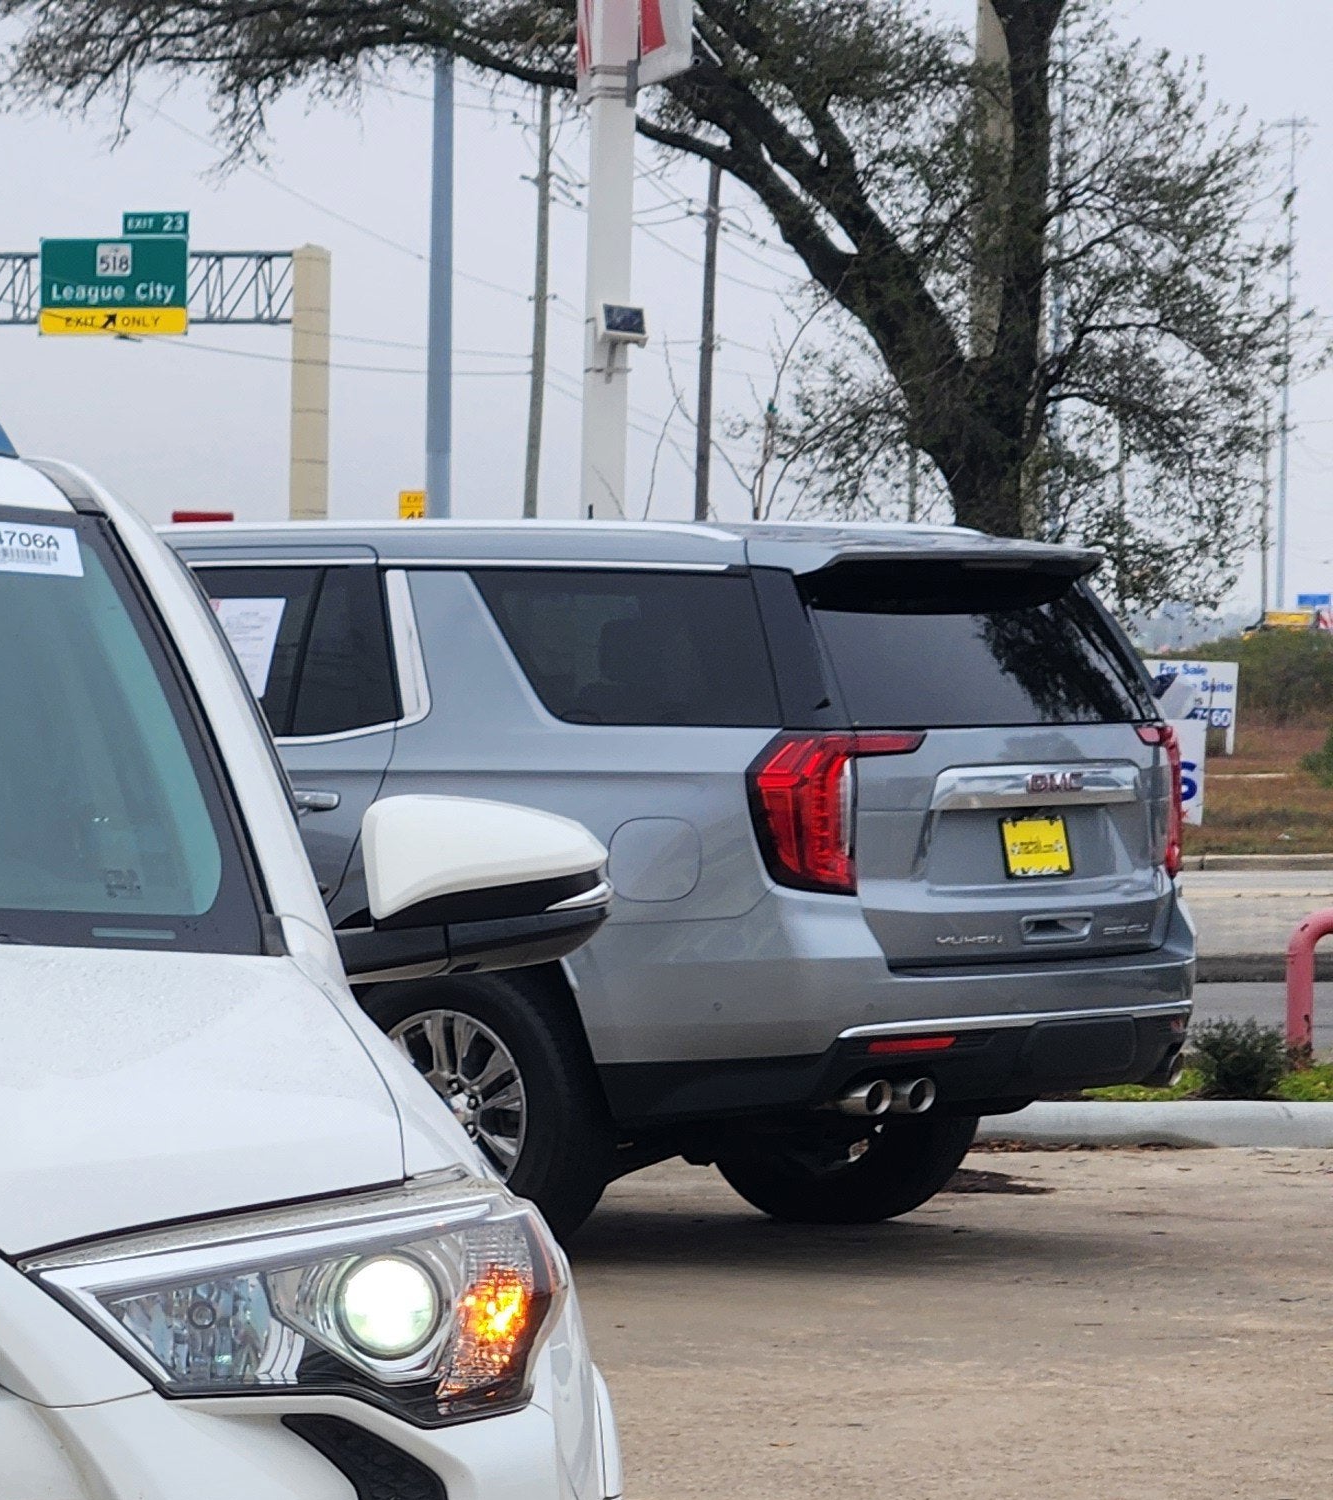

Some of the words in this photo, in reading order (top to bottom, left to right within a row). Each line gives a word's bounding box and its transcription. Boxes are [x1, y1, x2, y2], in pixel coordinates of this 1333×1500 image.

[126, 217, 154, 230] EXIT
[162, 215, 184, 231] 23
[99, 255, 129, 272] 518
[51, 282, 125, 305] League
[135, 281, 175, 305] City
[64, 316, 95, 328] EXIT
[121, 315, 161, 328] ONLY
[1182, 663, 1208, 676] Sale
[1026, 772, 1083, 793] GMC
